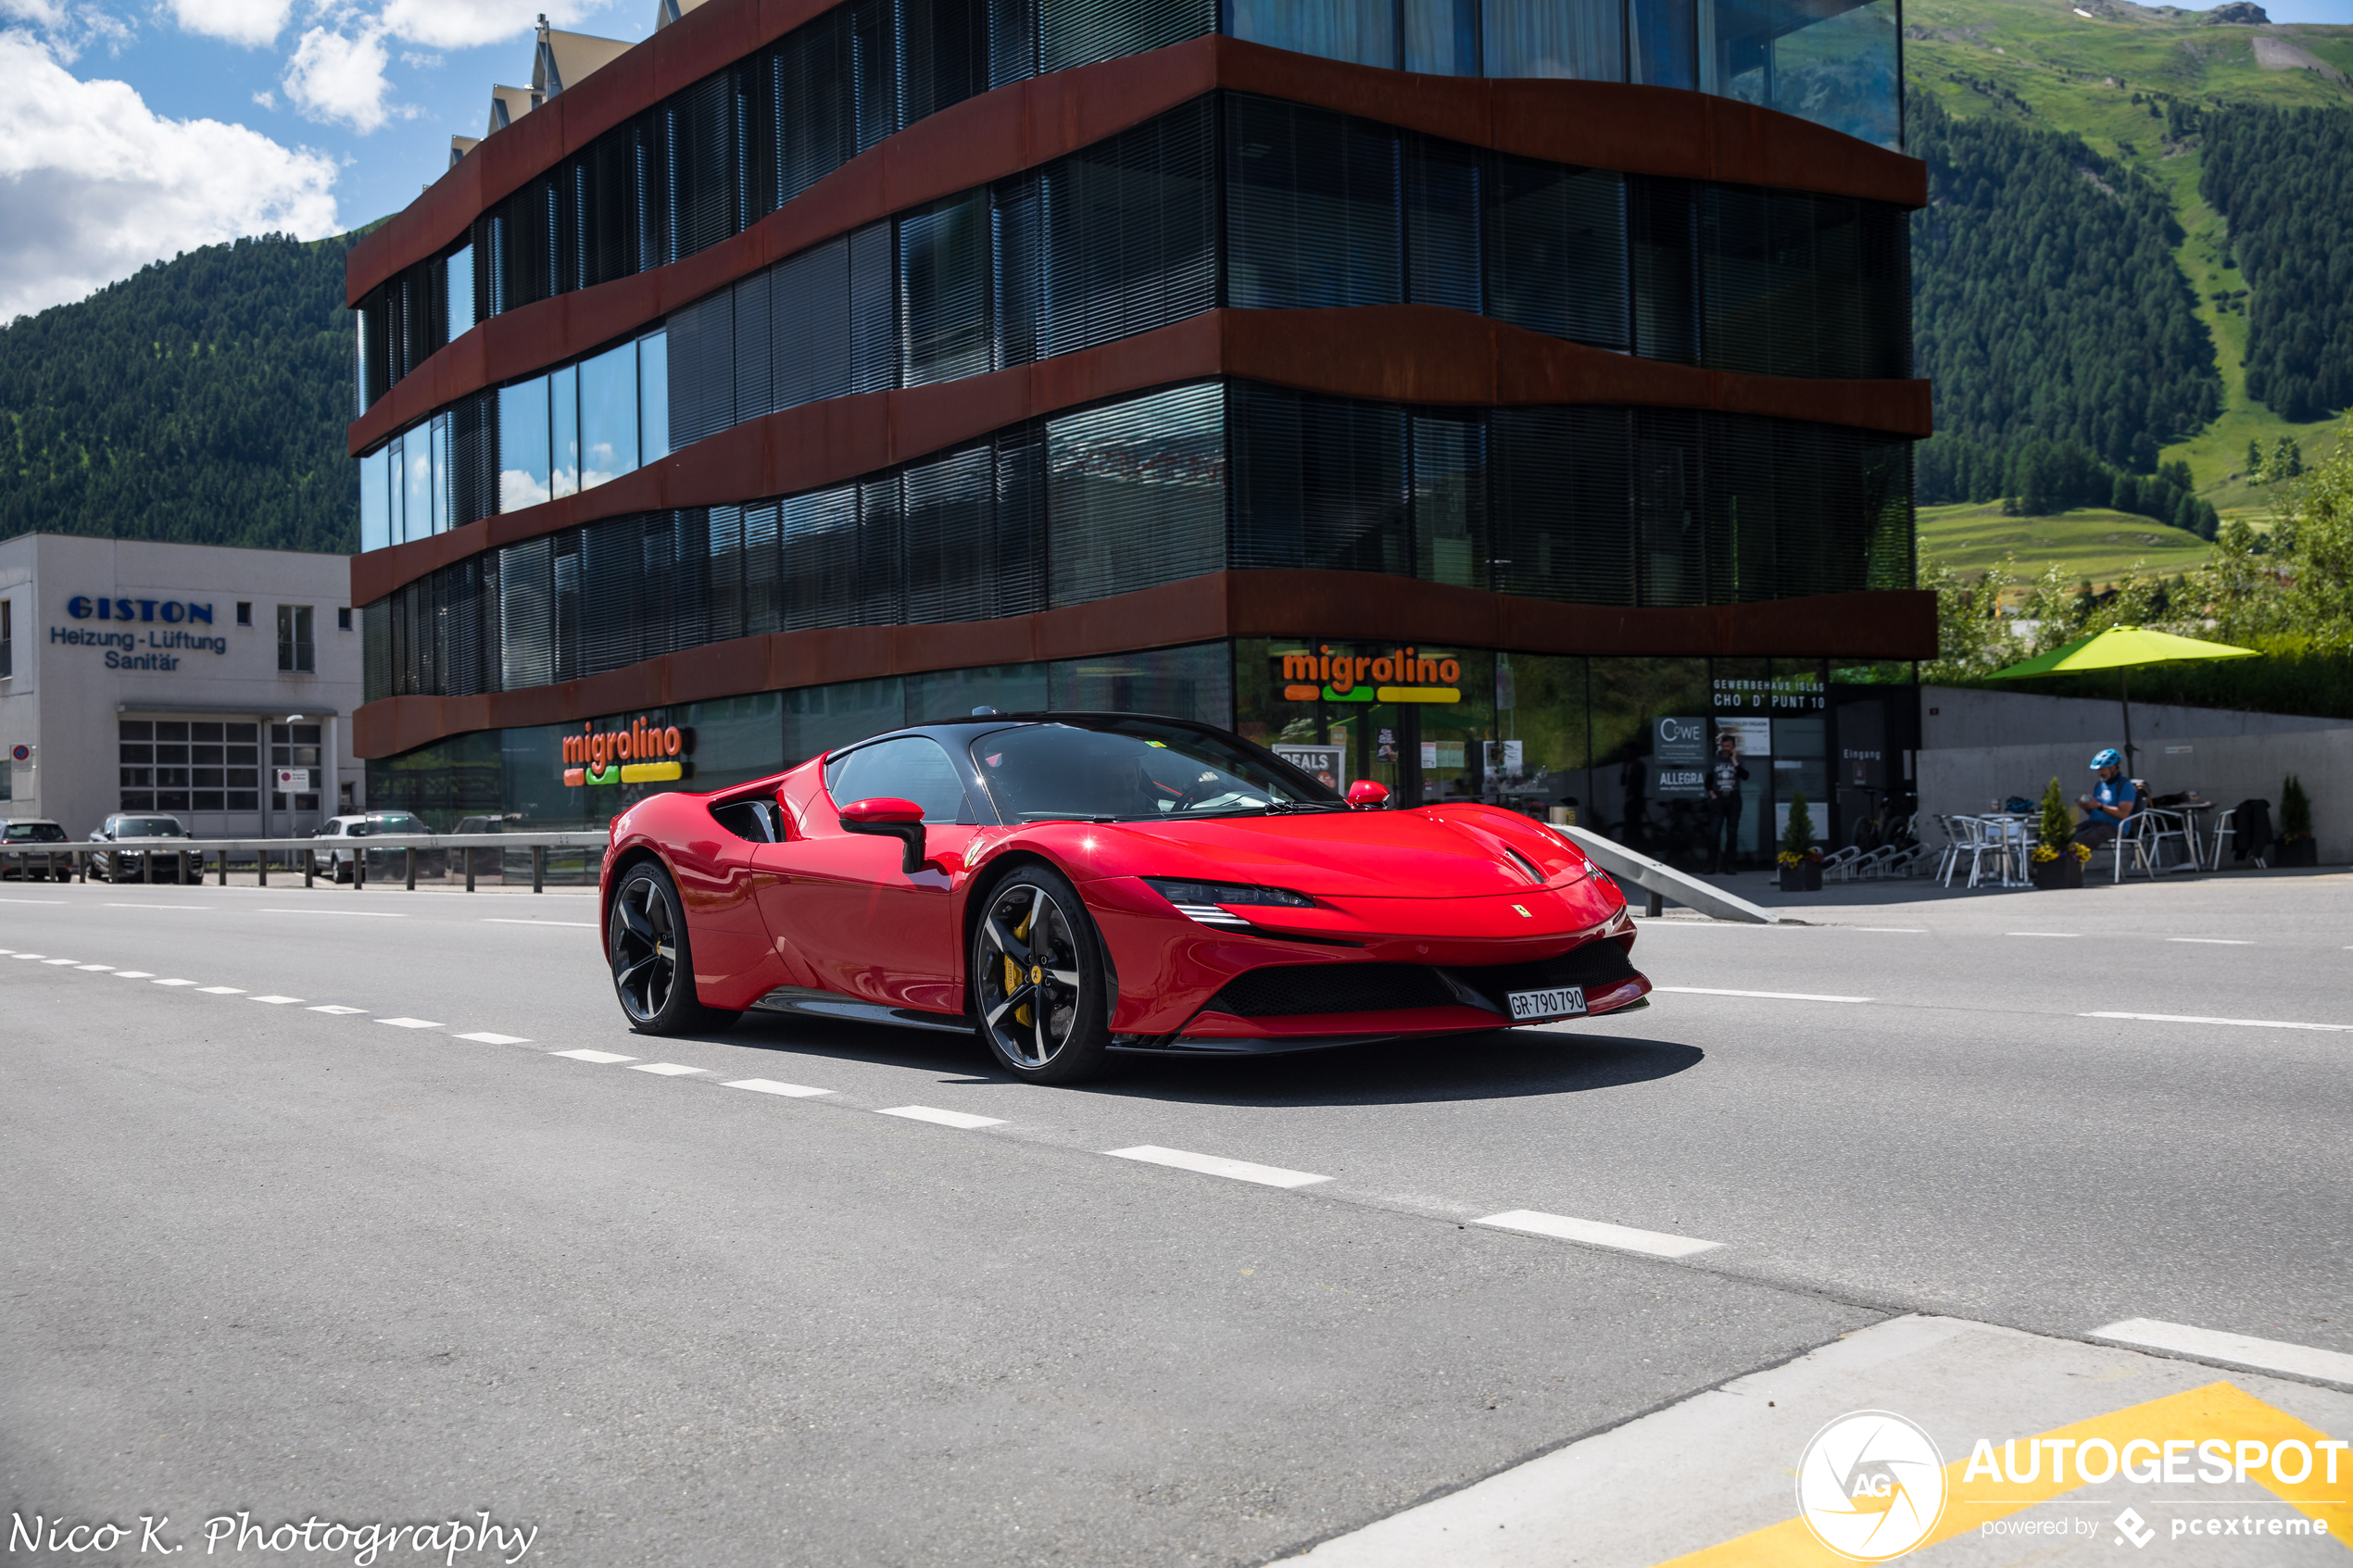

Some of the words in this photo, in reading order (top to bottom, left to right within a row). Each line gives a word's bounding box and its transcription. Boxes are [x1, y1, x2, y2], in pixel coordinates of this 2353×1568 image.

[68, 596, 213, 624] GISTON
[105, 651, 180, 671] Sanitär
[1283, 645, 1461, 693] migrolino
[1713, 679, 1792, 691] GEWERBEHAUS
[1795, 682, 1825, 693] ISLAS
[1714, 693, 1742, 707] CHO
[1771, 696, 1806, 709] PUNT
[1811, 696, 1825, 709] 10
[563, 716, 682, 774] migrolino
[1843, 748, 1881, 761] Eingang
[1660, 771, 1705, 785] ALLEGRA
